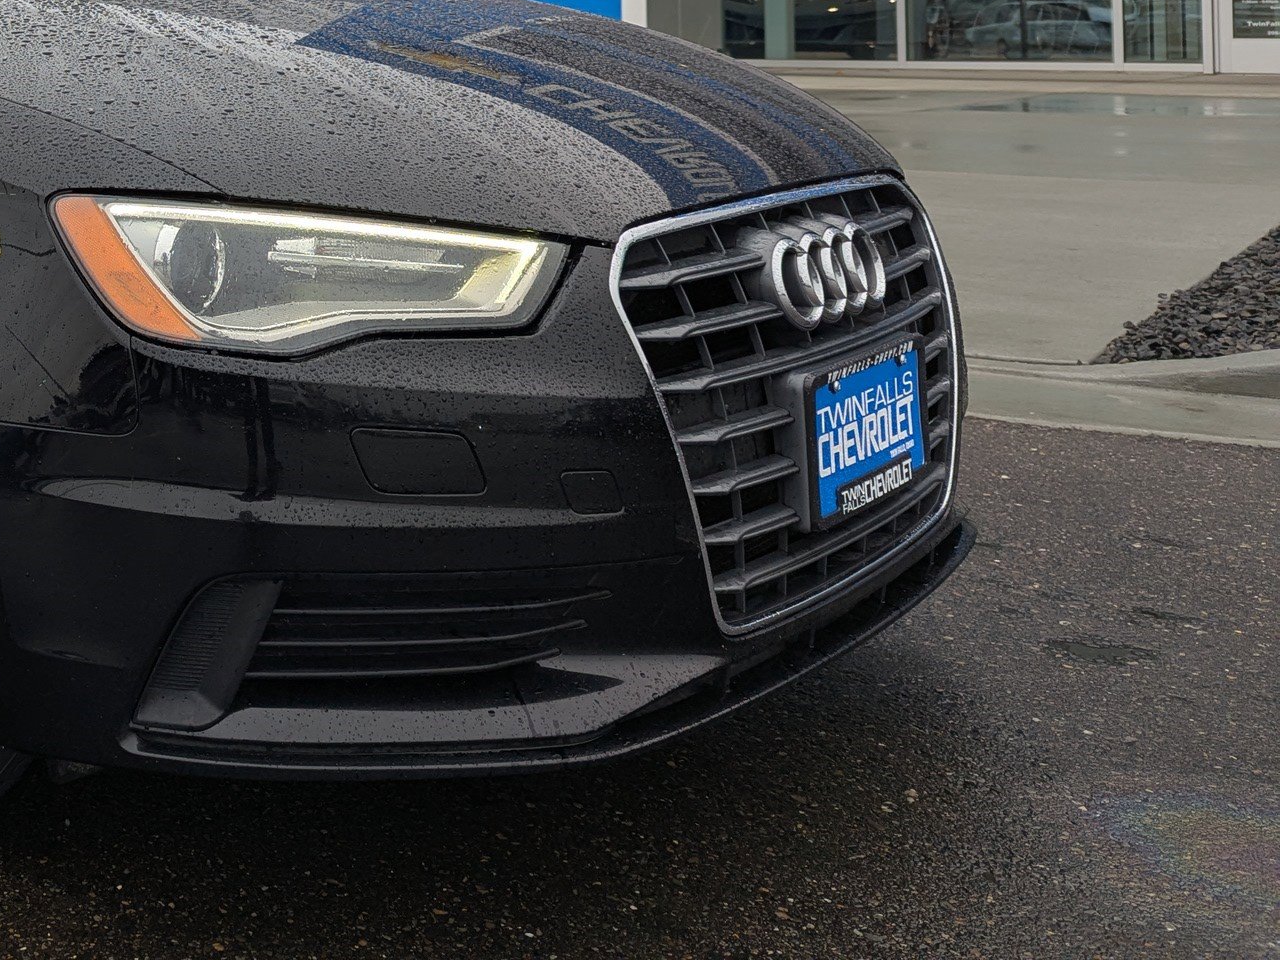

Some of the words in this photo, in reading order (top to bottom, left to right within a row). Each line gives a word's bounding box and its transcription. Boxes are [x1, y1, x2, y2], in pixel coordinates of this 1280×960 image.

[816, 371, 914, 433] TWINFALLS
[818, 394, 914, 478] CHEVROLET
[841, 484, 866, 503] TWIN
[864, 458, 913, 504] CHEVROLET
[842, 496, 866, 515] FALLS
